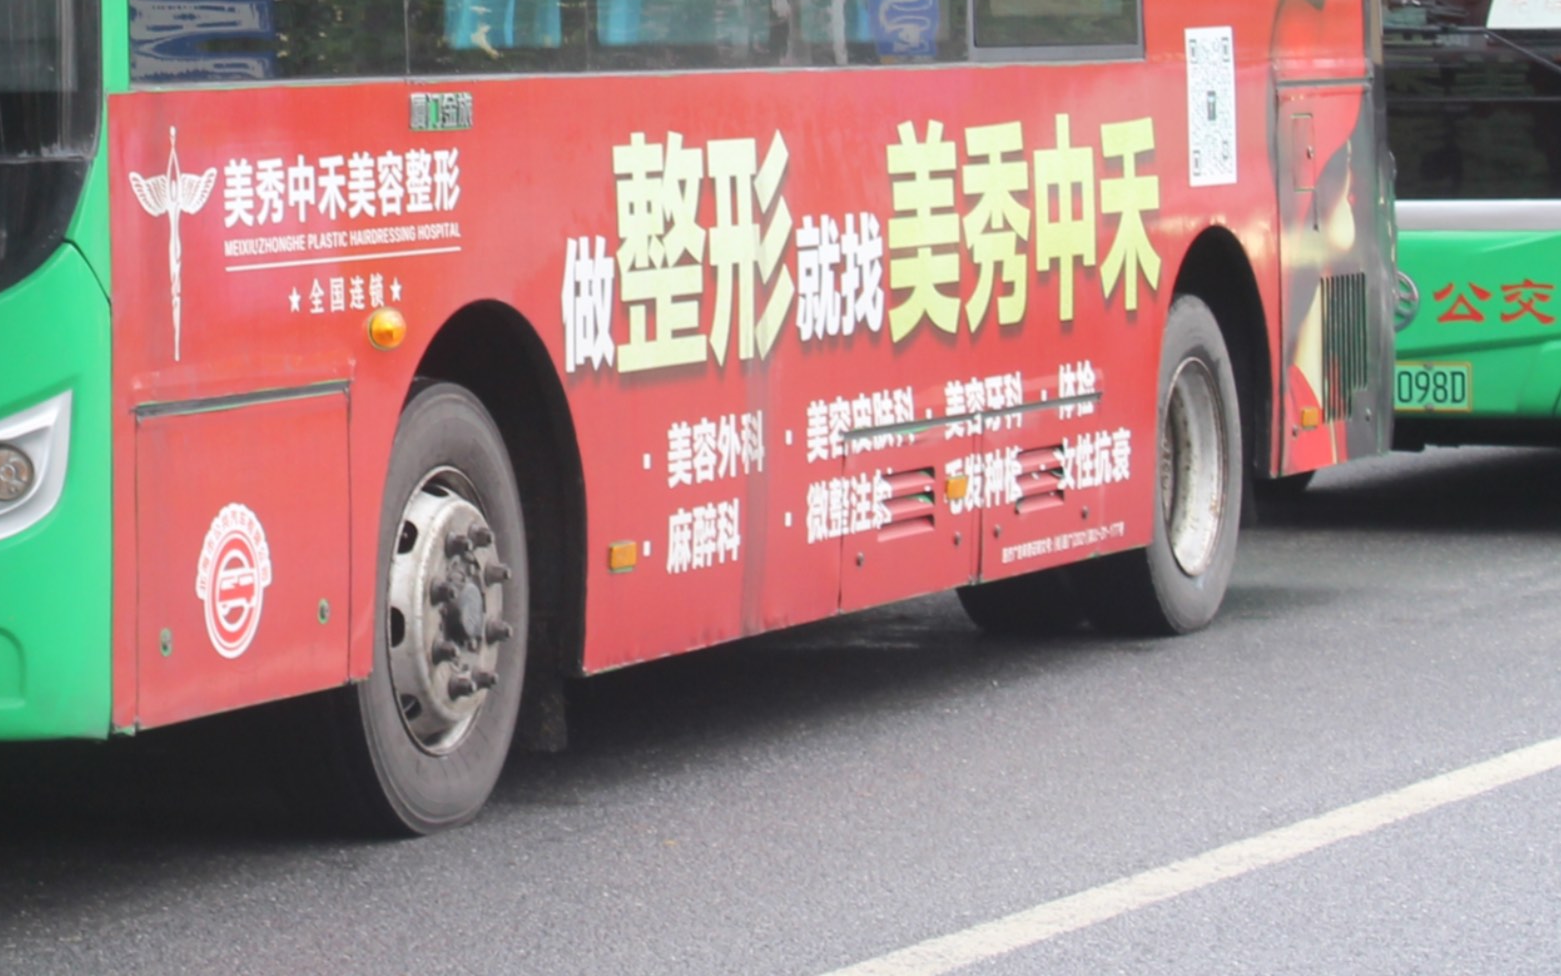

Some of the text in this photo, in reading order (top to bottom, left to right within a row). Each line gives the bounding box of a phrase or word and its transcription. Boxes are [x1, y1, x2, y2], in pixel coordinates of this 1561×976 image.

[223, 147, 461, 228] 美秀中禾美容整形
[224, 222, 461, 257] MEIXIUZHONGHE PLASTIC HAIRDRESSING HOSPITAL
[308, 273, 385, 314] 全国连锁
[1432, 277, 1556, 325] 公交
[667, 409, 765, 488] 美容外科
[806, 386, 916, 464] 美容皮肤科
[666, 498, 741, 574] 麻醉科
[1056, 427, 1132, 491] 女性抗衰
